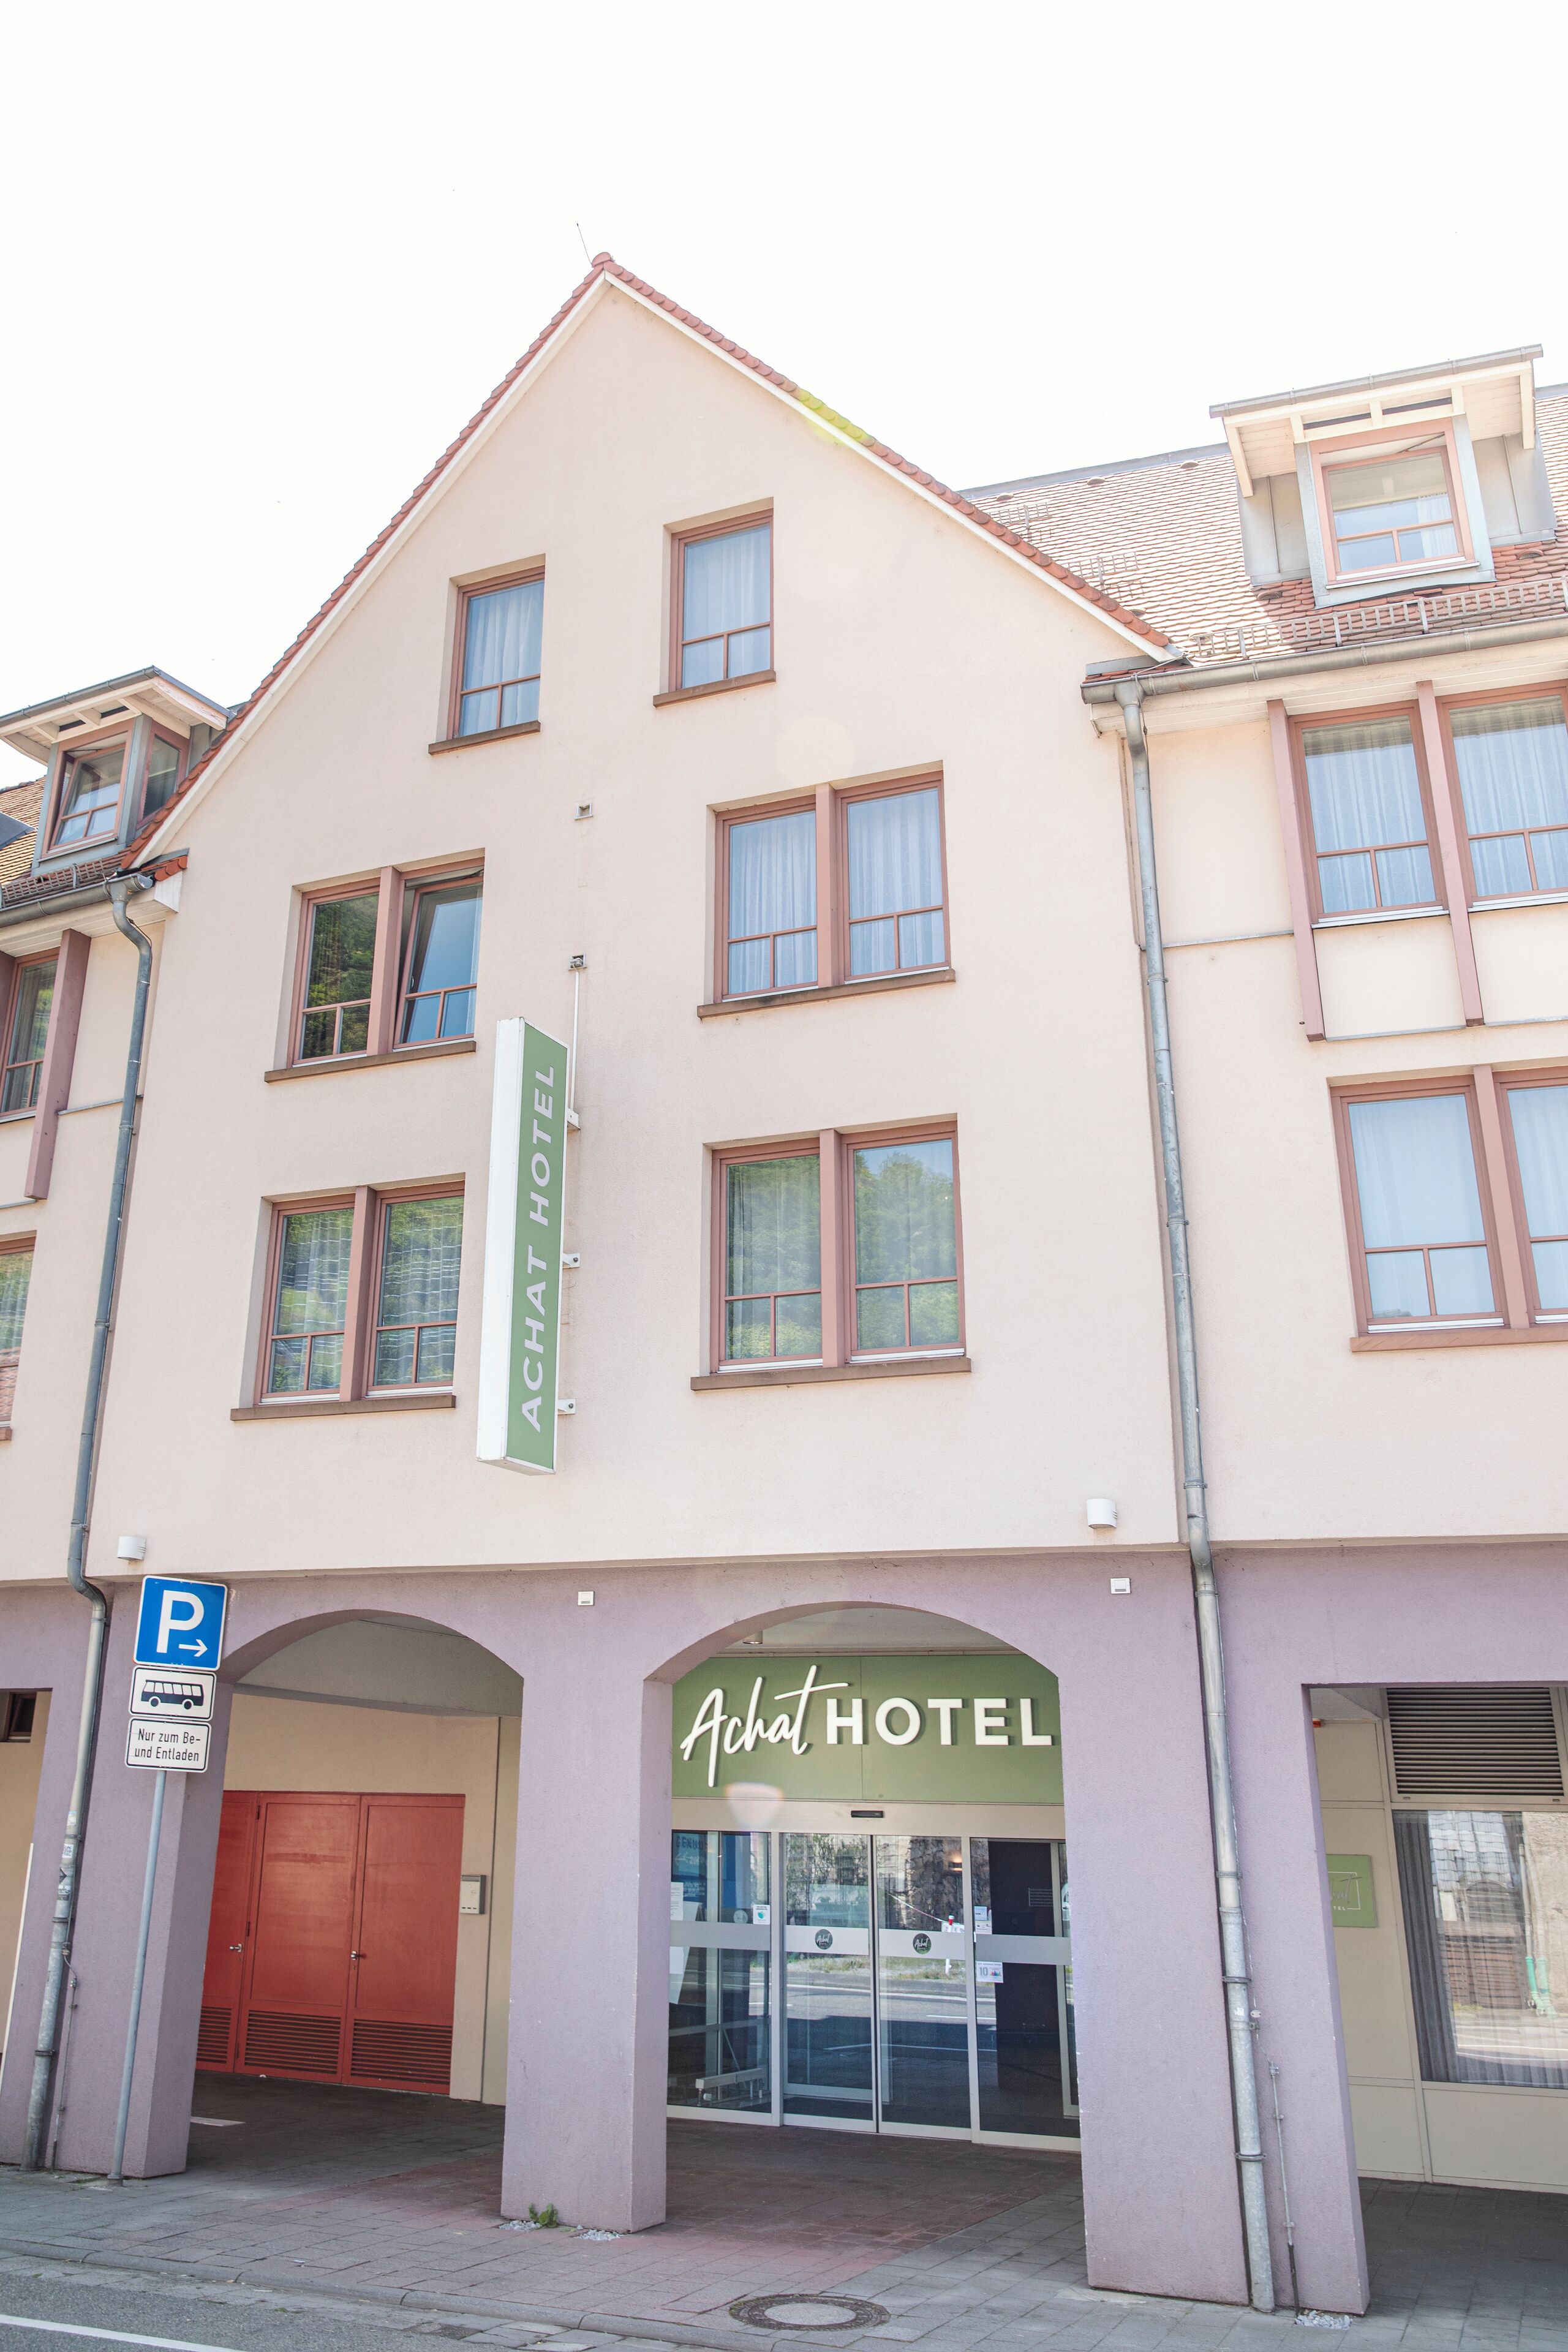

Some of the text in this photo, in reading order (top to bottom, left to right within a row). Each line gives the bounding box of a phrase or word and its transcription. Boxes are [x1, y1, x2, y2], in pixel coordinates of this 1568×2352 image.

[522, 1066, 554, 1433] ACHAT HOTEL
[156, 1589, 205, 1653] P
[135, 1746, 199, 1762] und Entladen
[138, 1728, 200, 1744] Nur zum Be-
[680, 1665, 1052, 1787] Achat HOTEL
